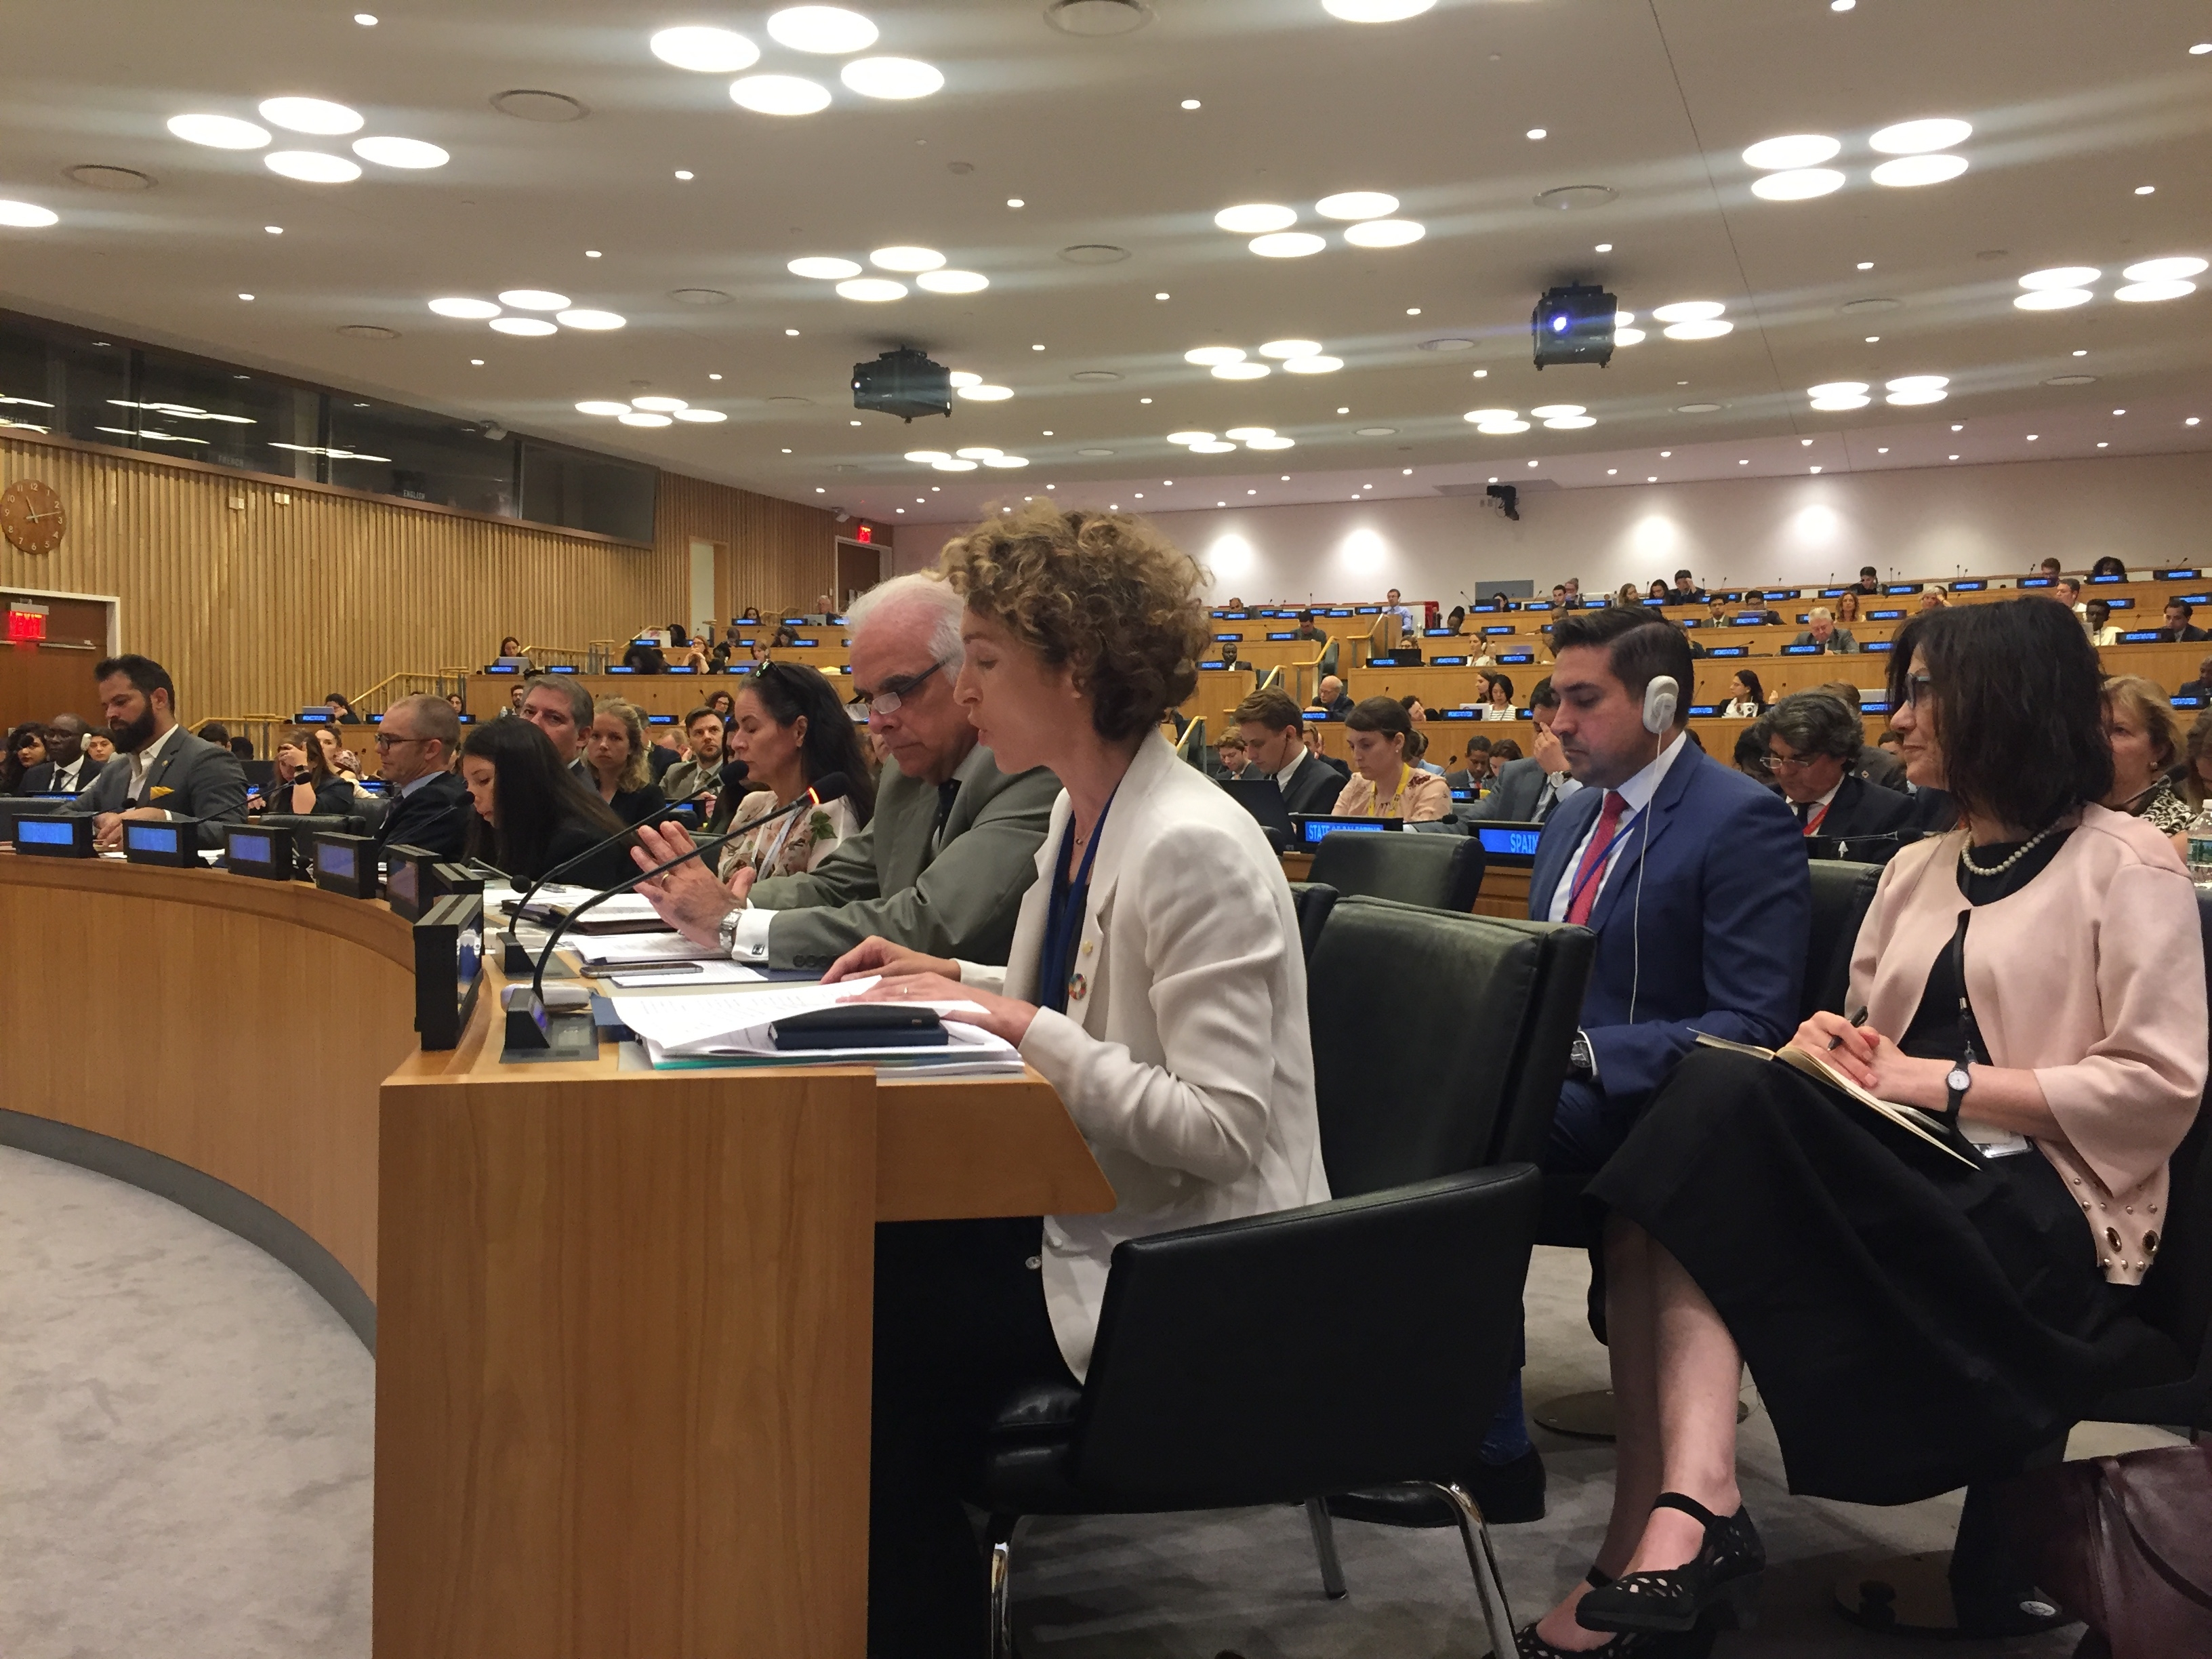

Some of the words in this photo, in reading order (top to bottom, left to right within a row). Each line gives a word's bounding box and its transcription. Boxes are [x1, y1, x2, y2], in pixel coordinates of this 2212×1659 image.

[30, 483, 38, 491] 12
[403, 489, 425, 500] ENGLISH
[7, 495, 15, 503] 10
[54, 501, 60, 509] 2
[5, 508, 10, 517] 9
[58, 516, 63, 525] 3
[8, 525, 14, 533] 8
[52, 531, 59, 539] 4
[19, 537, 24, 545] 7
[44, 540, 50, 548] 5
[31, 542, 37, 551] 6
[1510, 833, 1539, 855] SPAIN
